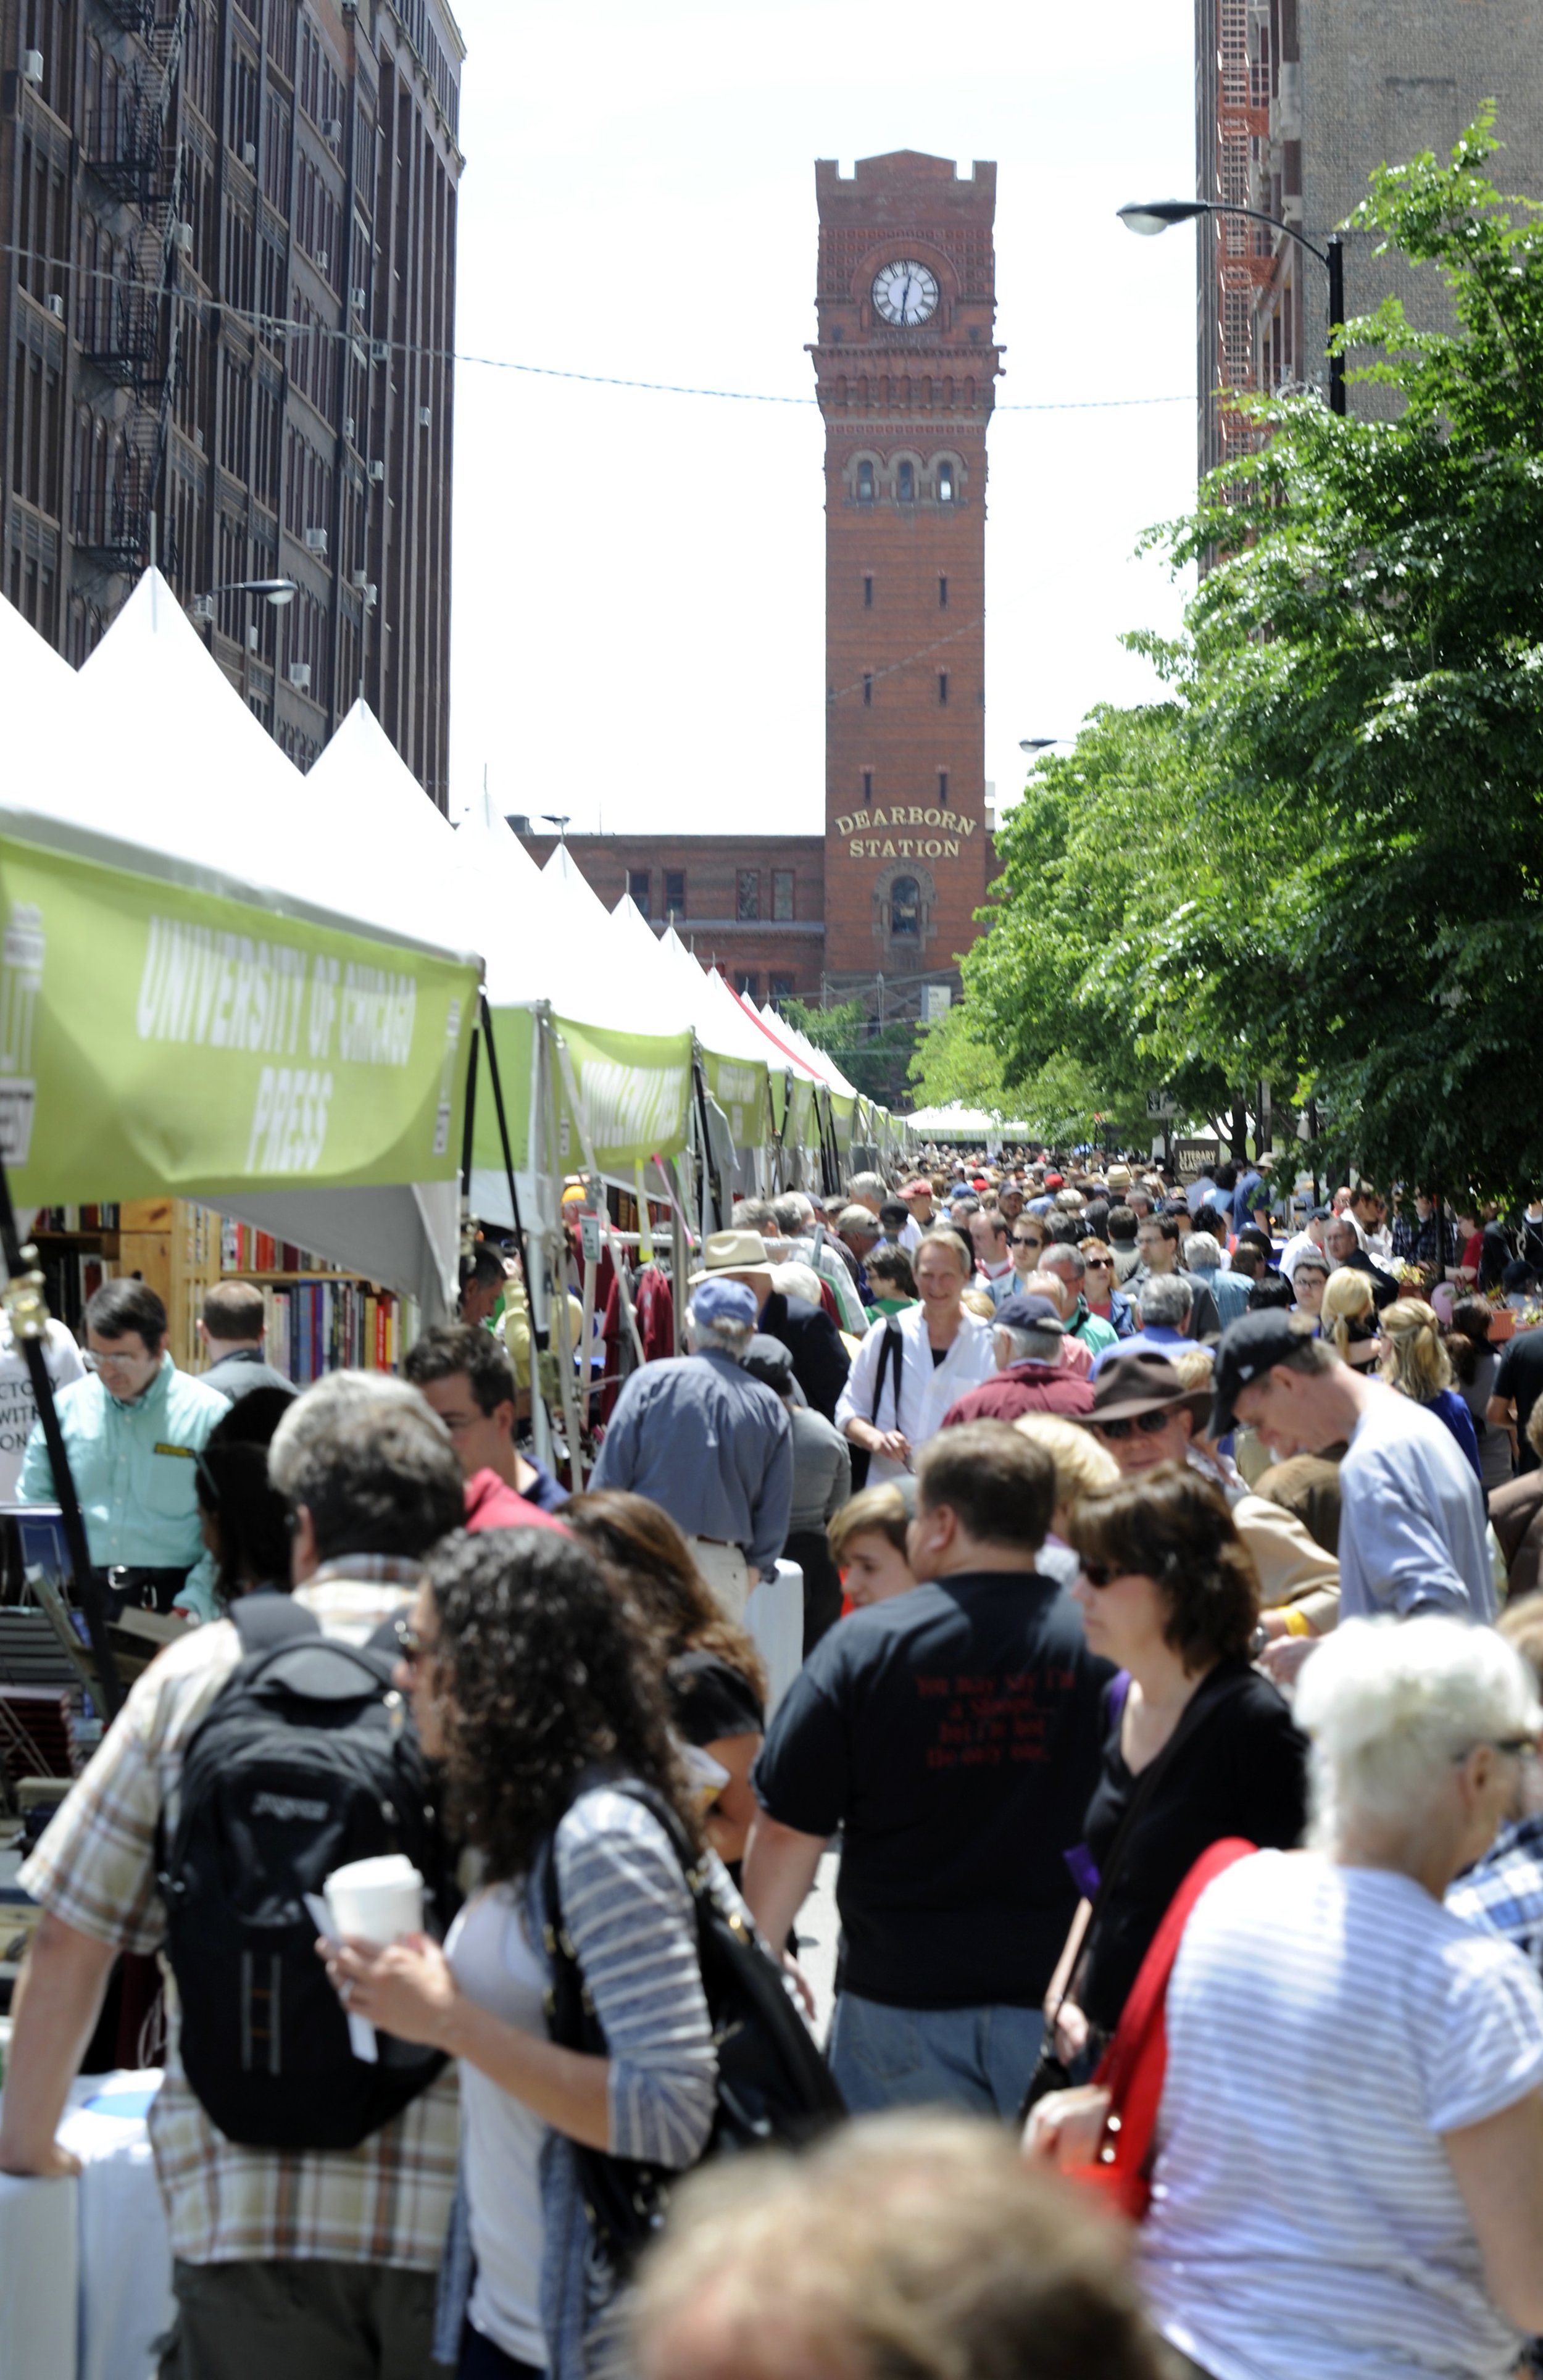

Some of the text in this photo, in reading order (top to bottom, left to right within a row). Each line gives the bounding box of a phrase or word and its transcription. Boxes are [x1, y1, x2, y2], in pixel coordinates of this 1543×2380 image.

[834, 806, 977, 837] DEARBORN
[849, 839, 961, 858] STATION
[136, 913, 309, 1055] UNIVERSITY
[309, 952, 339, 1060] OF
[244, 1065, 333, 1173] PRESS
[1179, 1150, 1216, 1162] LITERARY
